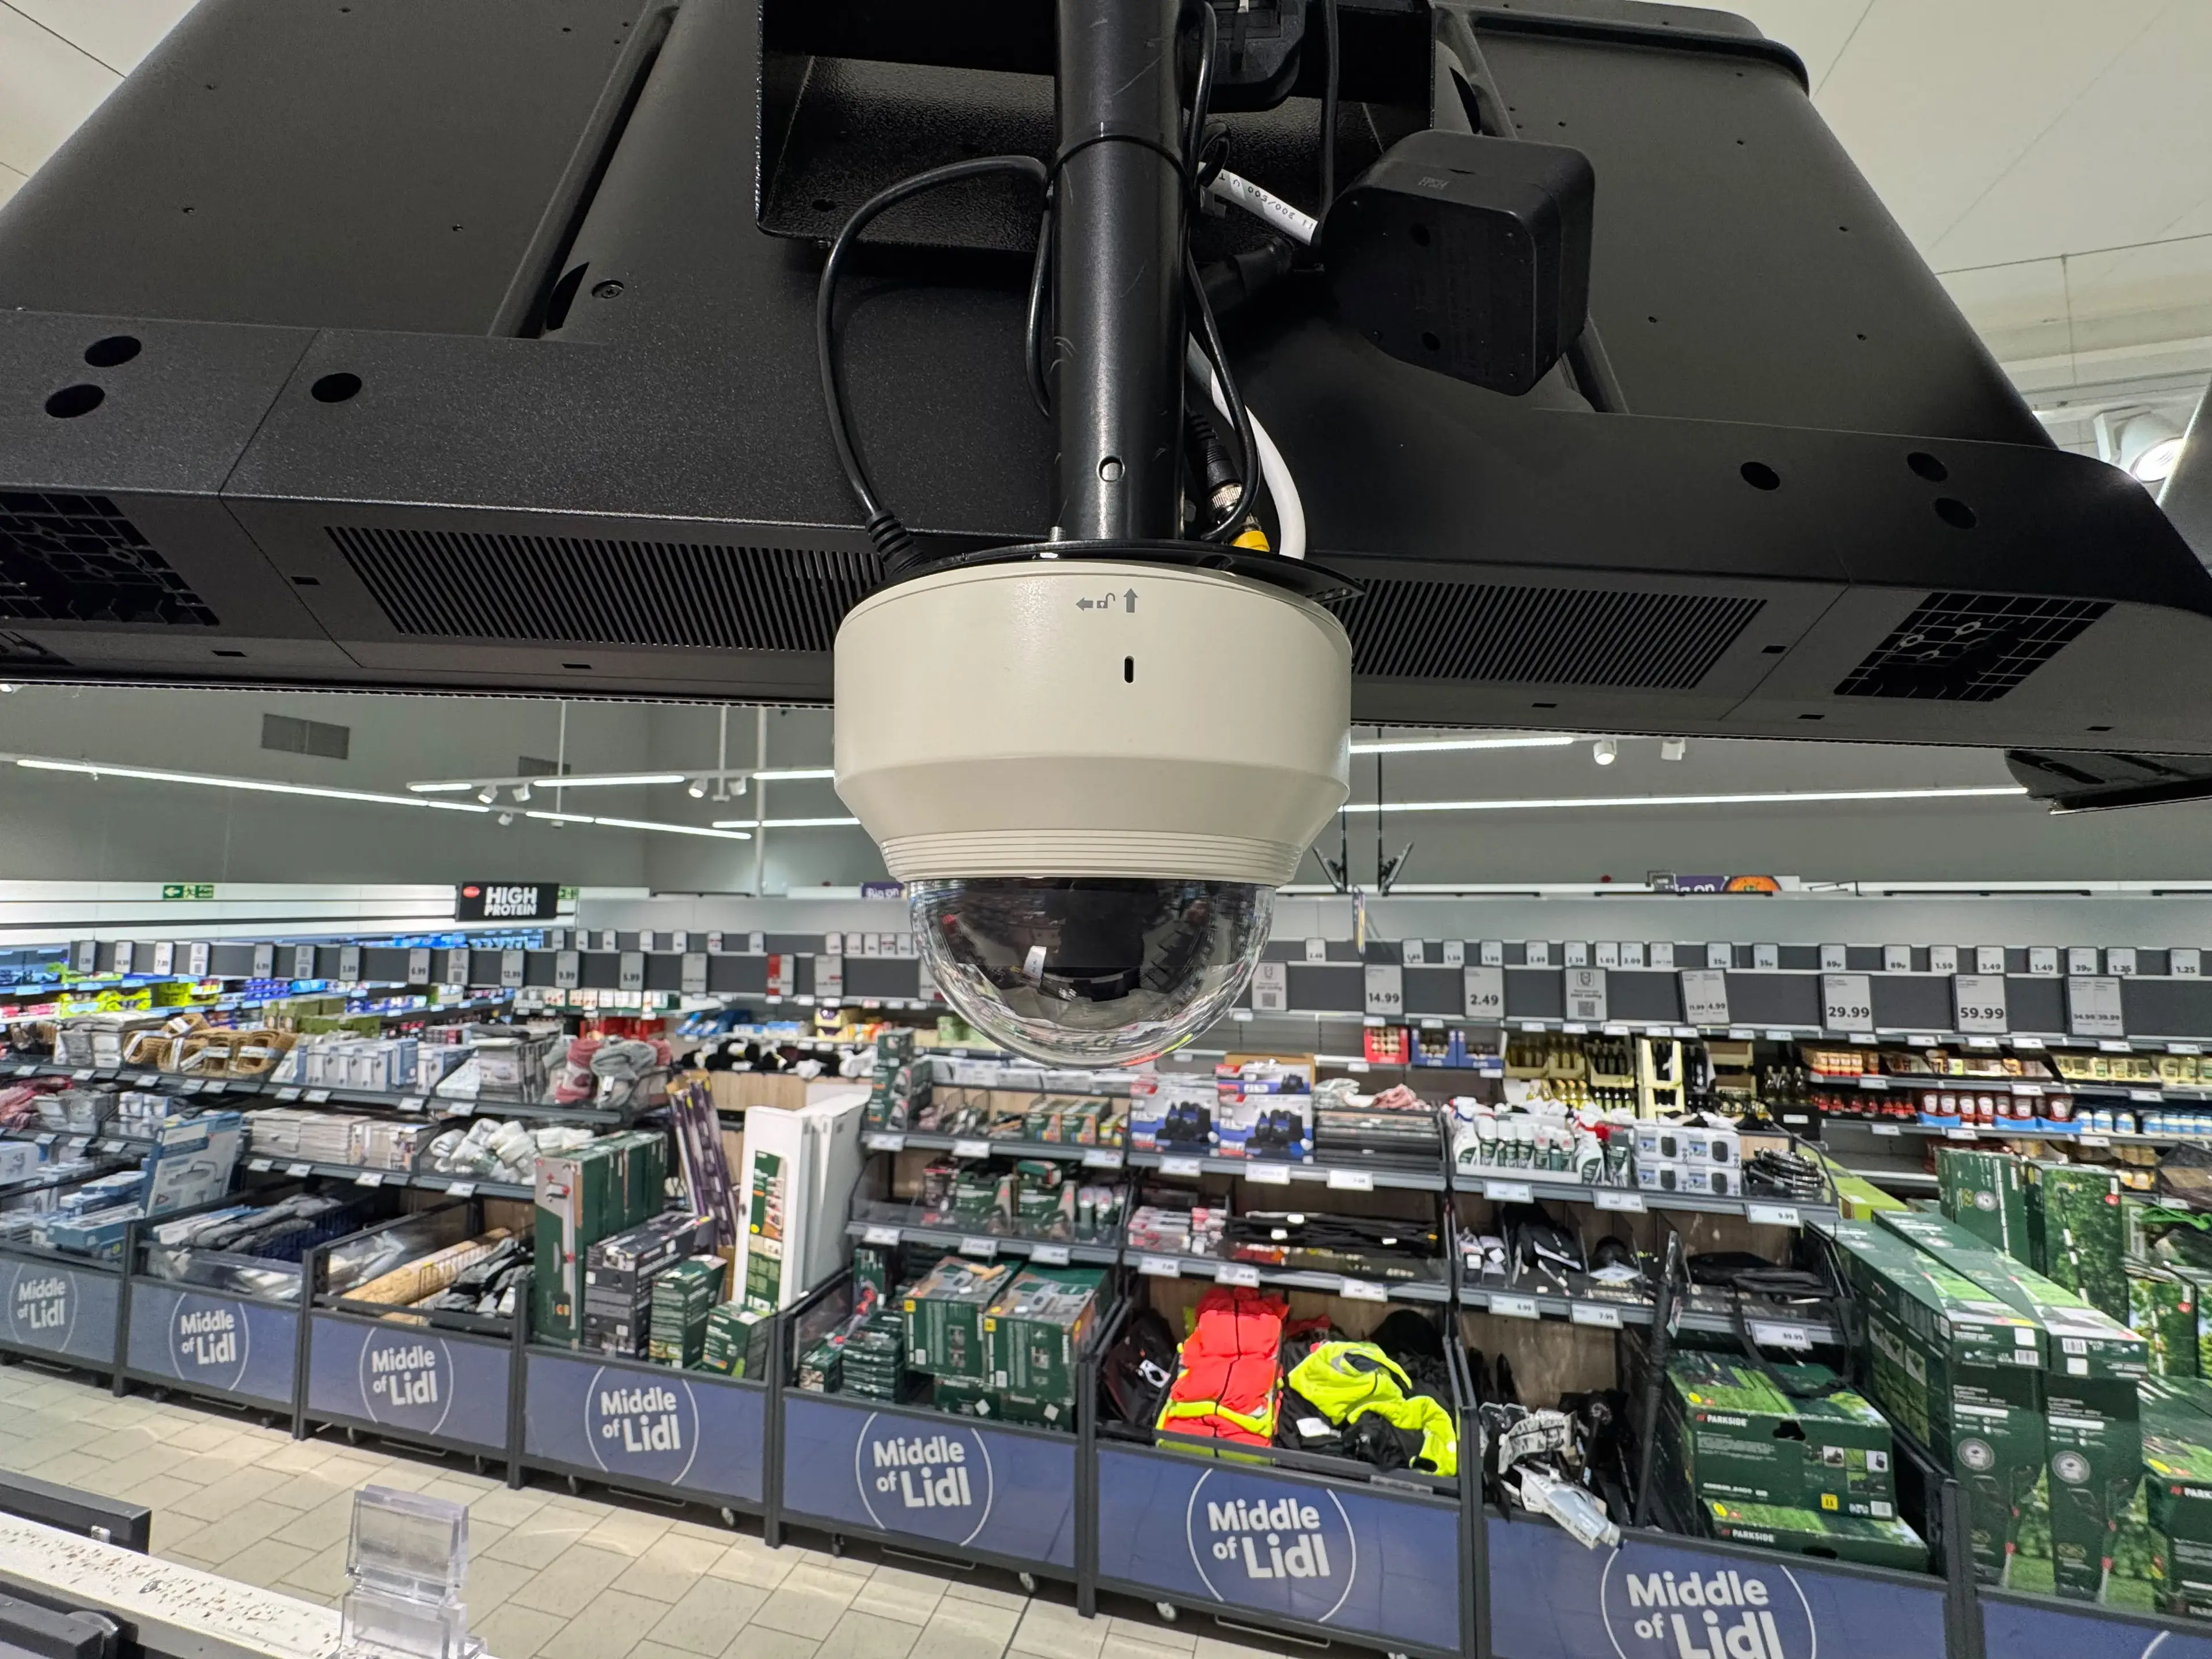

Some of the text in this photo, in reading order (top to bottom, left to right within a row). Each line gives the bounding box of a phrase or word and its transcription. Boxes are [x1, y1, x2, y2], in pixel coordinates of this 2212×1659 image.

[1233, 179, 1240, 187] V
[1248, 185, 1295, 220] 300/500
[484, 903, 537, 916] PROTEIN
[486, 887, 538, 904] HIGH
[1368, 992, 1400, 1004] 14.99
[1470, 994, 1499, 1006] 2.49
[1708, 1002, 1726, 1010] 4.99
[1828, 1006, 1870, 1018] 29.99
[1960, 1007, 2004, 1020] 59.99
[18, 1277, 66, 1302] Middle
[17, 1298, 66, 1329] of Lidl
[180, 1309, 235, 1335] Middle
[181, 1332, 236, 1365] of Lidl
[372, 1345, 435, 1373] Middle
[373, 1370, 438, 1406] of Lidl
[601, 1386, 677, 1415] Middle
[602, 1414, 681, 1452] of Lidl
[1707, 1414, 1748, 1427] PARKSIDE
[873, 1435, 965, 1468] Middle
[876, 1466, 972, 1508] of Lidl
[1207, 1498, 1320, 1531] Middle
[1213, 1533, 1331, 1578] of Lidl
[1626, 1570, 1769, 1607] Middle
[1634, 1609, 1785, 1659] of Lidl
